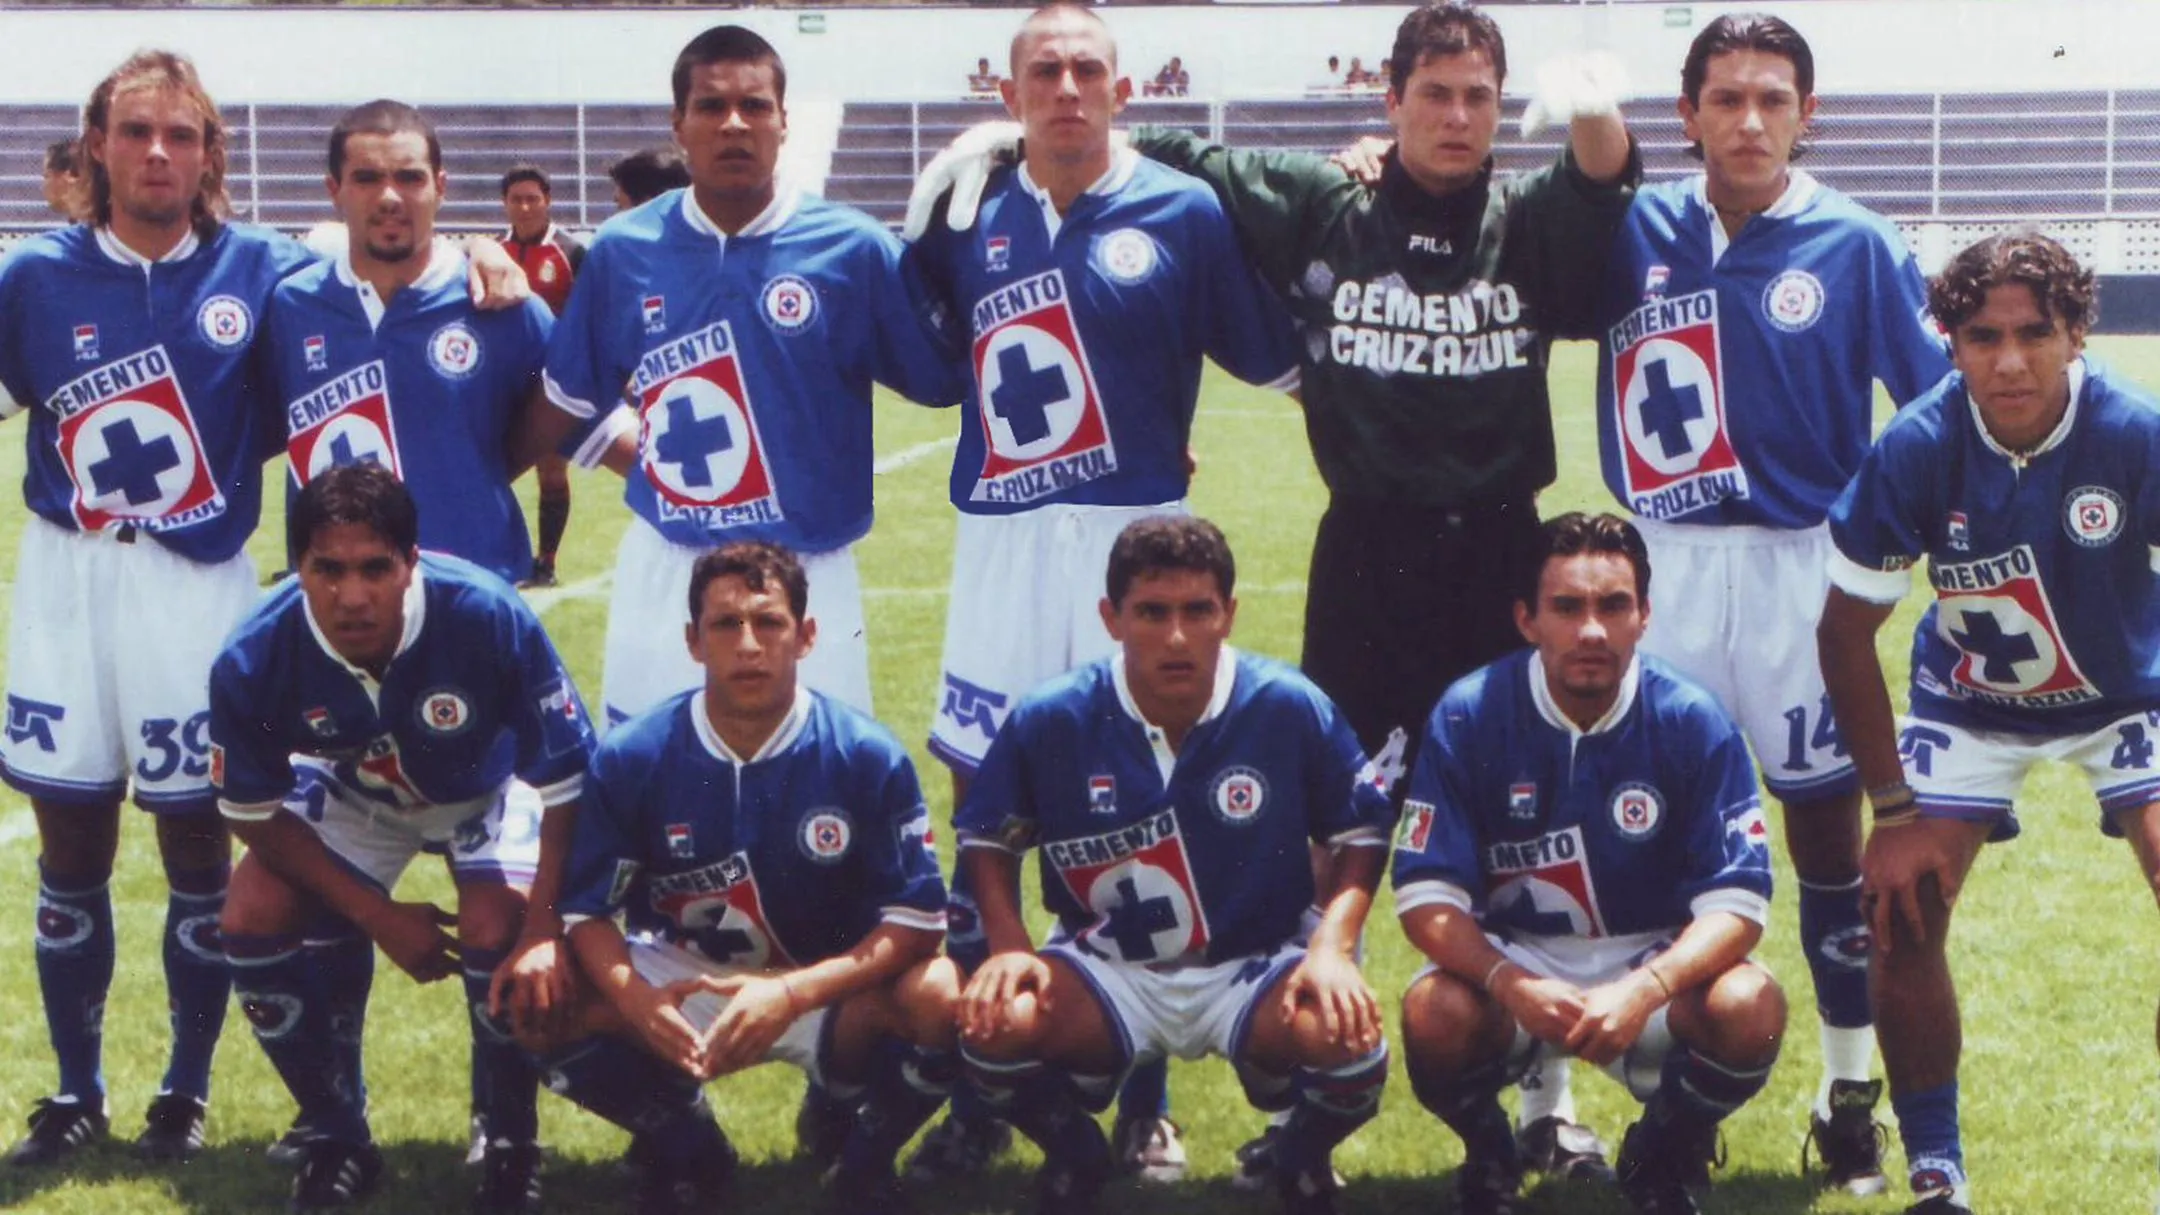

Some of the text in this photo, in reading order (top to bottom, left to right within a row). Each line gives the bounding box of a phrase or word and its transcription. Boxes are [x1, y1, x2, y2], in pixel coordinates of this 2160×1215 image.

[1408, 234, 1453, 254] FILA
[975, 273, 1062, 337] MENTO
[1333, 280, 1521, 334] CEMENTO
[1611, 294, 1713, 352] CEMENTO
[635, 325, 729, 388] EMENTO
[1331, 324, 1528, 376] CRUZ AZUL
[290, 364, 383, 430] EMENTO
[986, 448, 1115, 502] CRUZ AZUL
[1634, 481, 1700, 520] CRUZ
[1936, 548, 2031, 590] MENTO
[136, 709, 211, 782] 39
[1781, 690, 1851, 771] 14
[1050, 815, 1174, 867] CEMENTO
